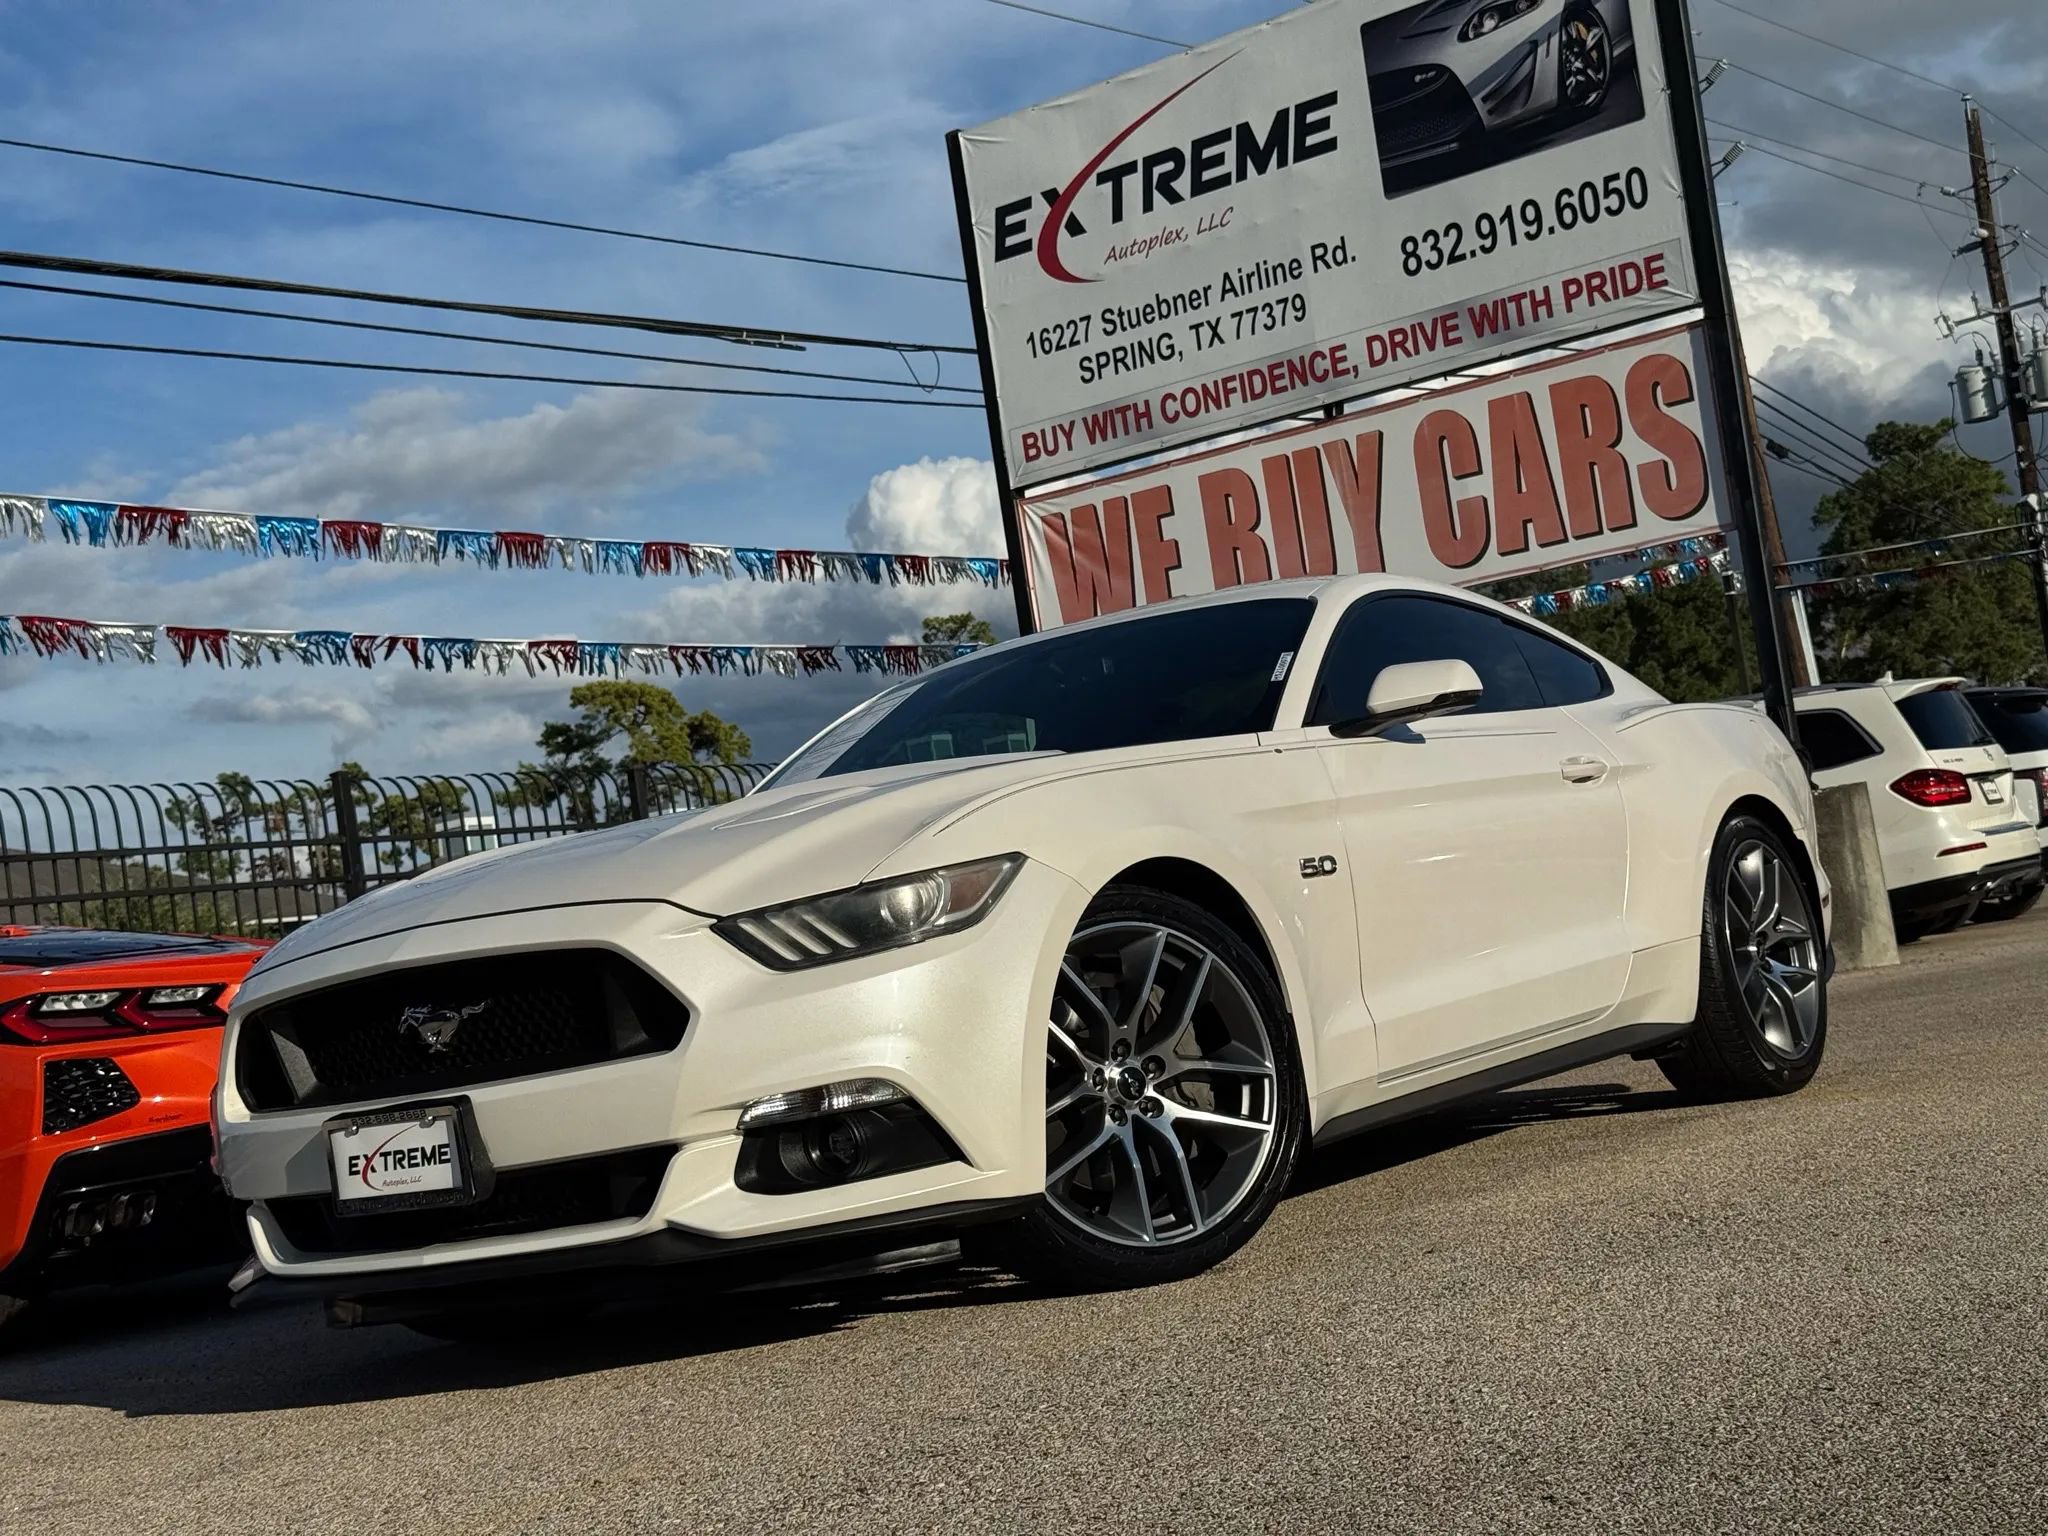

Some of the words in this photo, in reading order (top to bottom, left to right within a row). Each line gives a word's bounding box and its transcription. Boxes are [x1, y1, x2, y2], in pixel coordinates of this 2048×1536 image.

[994, 89, 1338, 264] EXTREME
[1400, 166, 1649, 277] 832.919.6050
[1103, 225, 1189, 266] Autoplex,
[1196, 206, 1234, 236] LLC
[1026, 315, 1093, 359] 16227
[1101, 285, 1213, 337] Stuebner
[1220, 257, 1303, 302] Airline
[1310, 236, 1356, 273] Rd.
[1078, 332, 1184, 385] SPRING,
[1189, 317, 1226, 352] TX
[1230, 293, 1307, 341] 77379
[1022, 420, 1076, 464] BUY
[1082, 399, 1153, 445] WITH
[1160, 343, 1360, 425] CONFIDENCE,
[1365, 311, 1464, 368] DRIVE
[1468, 285, 1554, 339] WITH
[1561, 252, 1669, 314] PRIDE
[1040, 484, 1183, 625] WE
[1198, 430, 1387, 591] BUY
[1413, 353, 1710, 569] CARS
[348, 1143, 451, 1176] EXTREME
